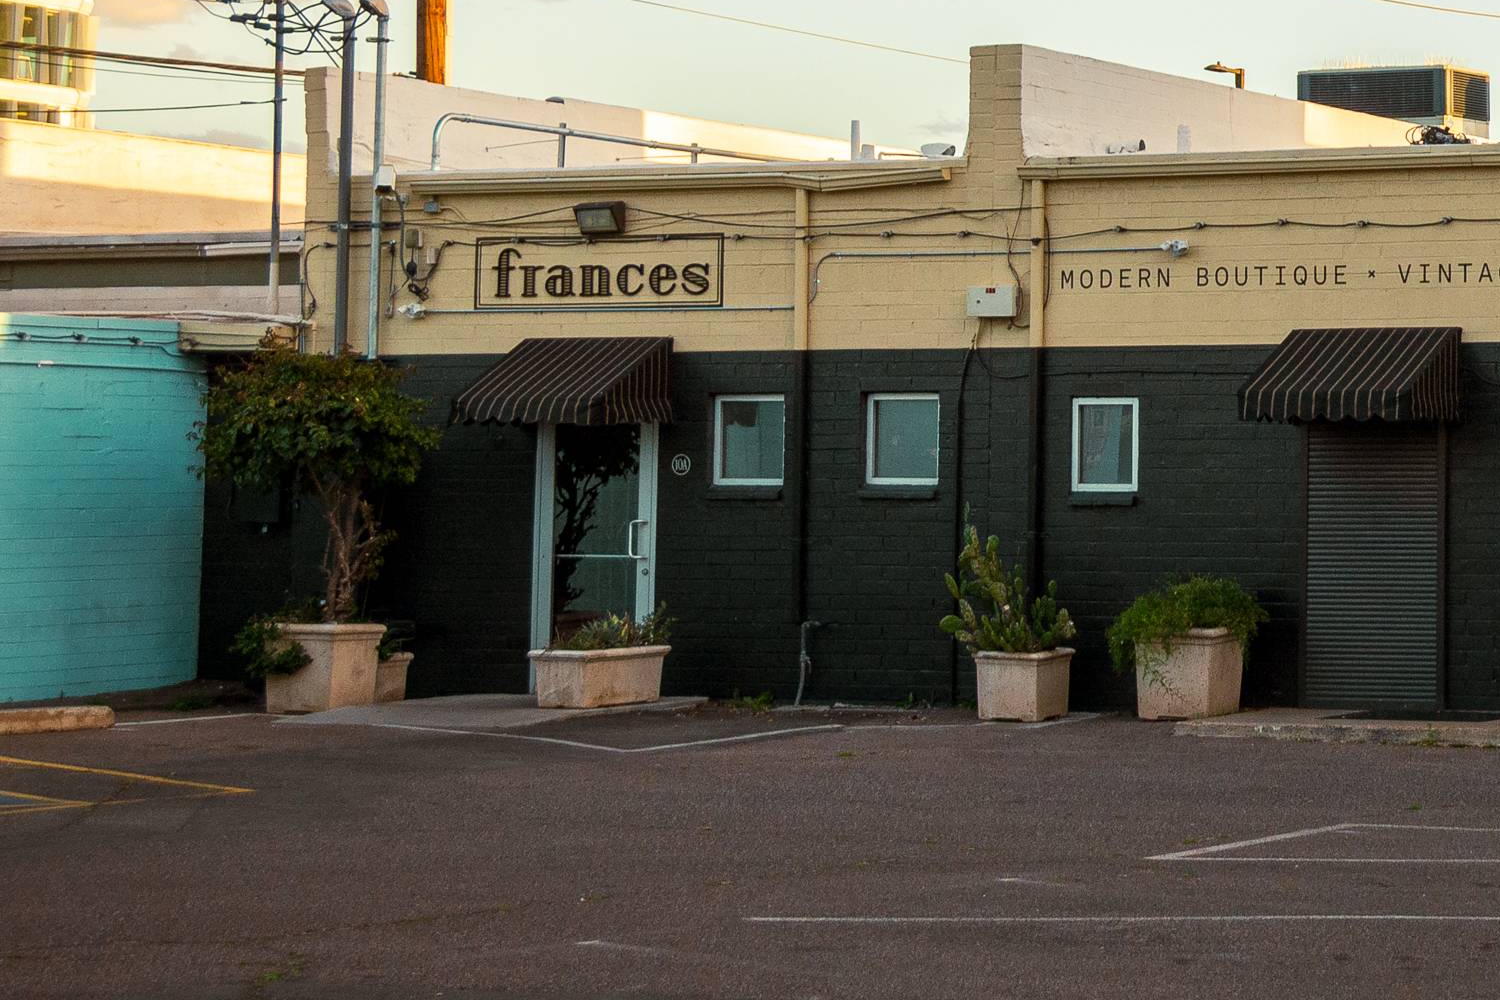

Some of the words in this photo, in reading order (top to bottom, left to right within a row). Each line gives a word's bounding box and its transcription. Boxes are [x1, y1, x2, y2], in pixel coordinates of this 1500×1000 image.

[492, 247, 710, 298] frances
[1060, 268, 1171, 290] MODERN
[1196, 264, 1348, 288] BOUTIQUE
